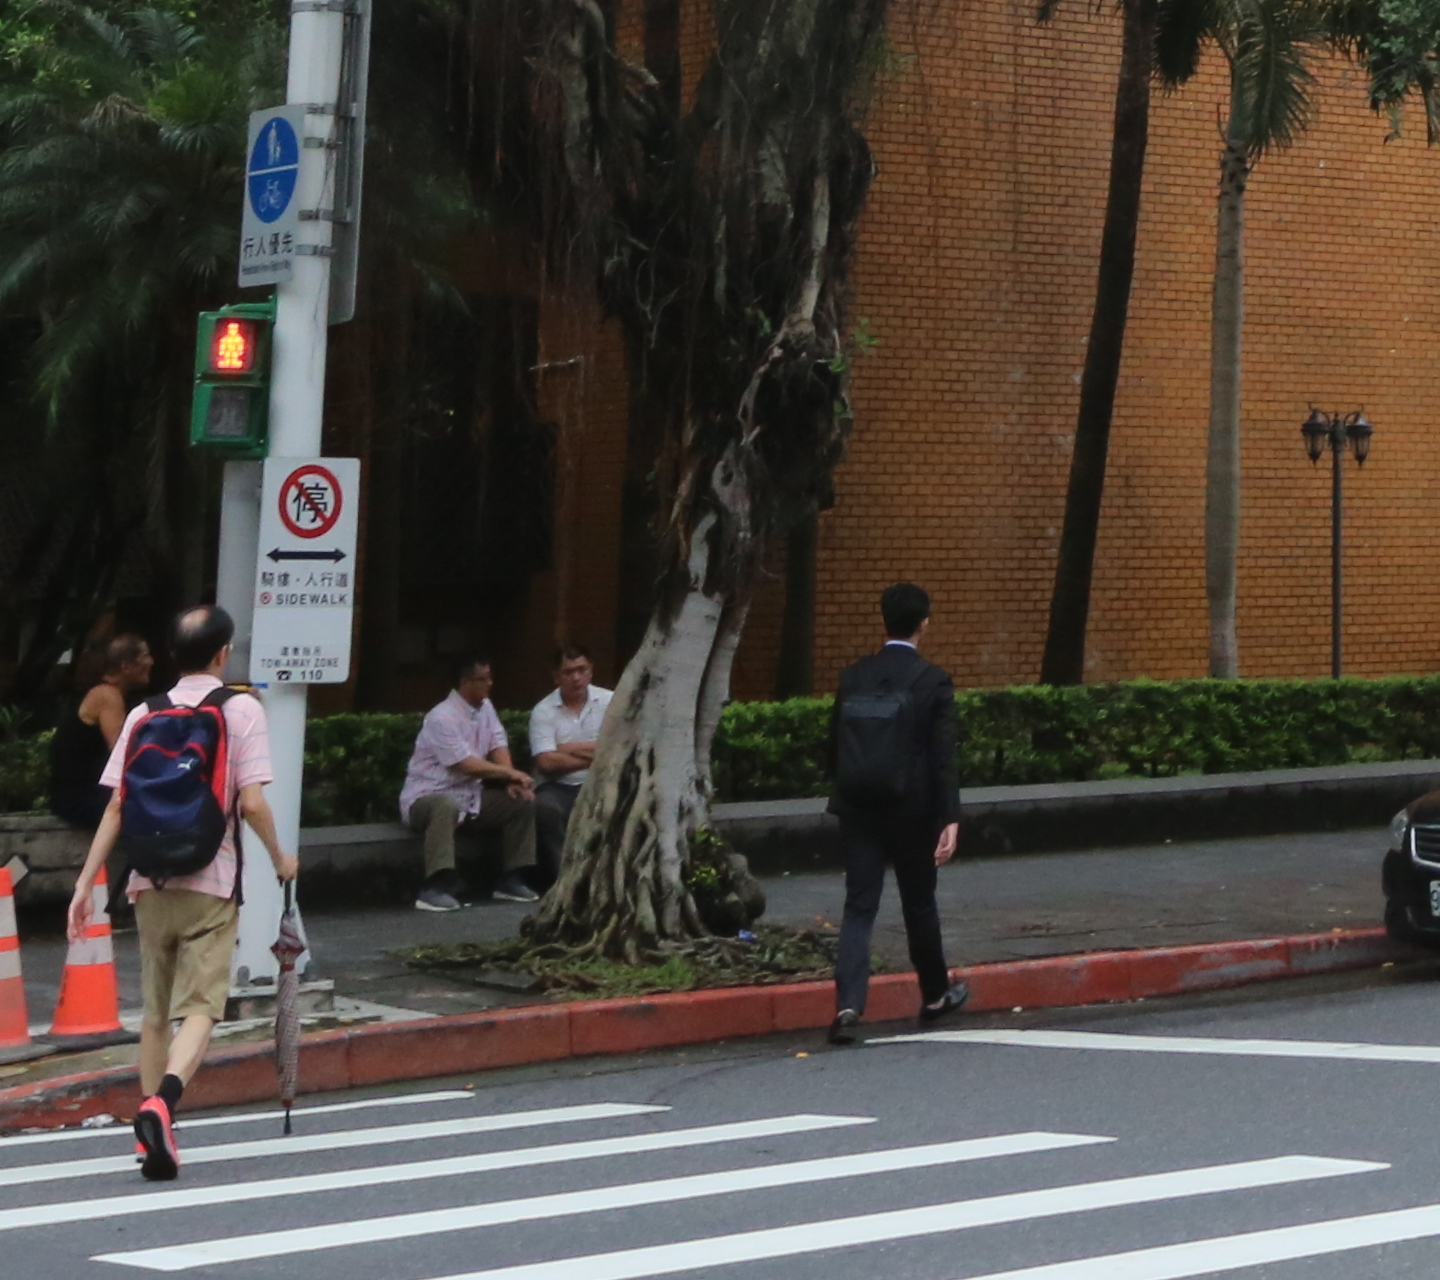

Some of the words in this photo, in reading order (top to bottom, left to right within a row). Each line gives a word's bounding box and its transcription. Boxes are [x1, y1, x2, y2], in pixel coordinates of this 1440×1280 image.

[243, 230, 294, 259] 行人優先
[292, 482, 328, 523] 停
[276, 592, 347, 606] SIDEWALK
[261, 658, 311, 669] TOW-AWAY
[314, 658, 339, 668] ZONE
[300, 670, 323, 681] 110
